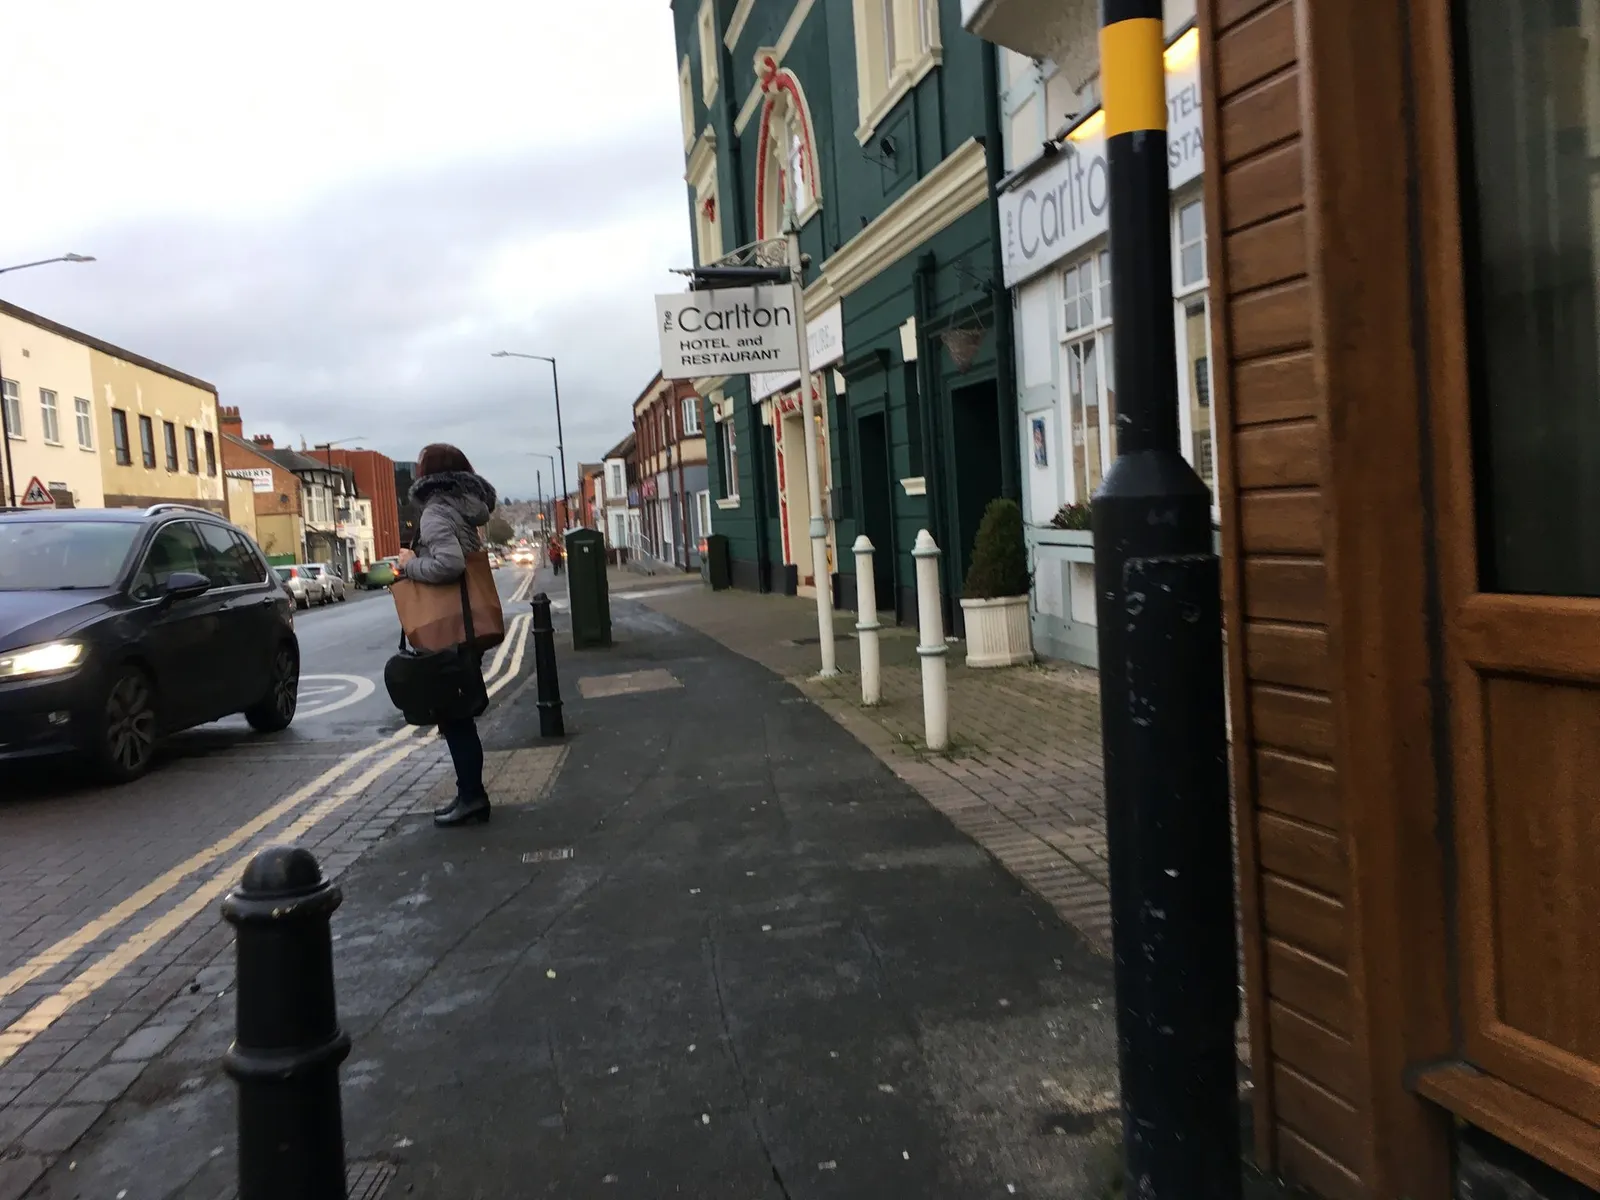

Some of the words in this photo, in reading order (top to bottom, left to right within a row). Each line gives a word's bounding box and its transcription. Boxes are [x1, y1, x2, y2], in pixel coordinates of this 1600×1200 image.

[1168, 82, 1203, 124] TEL
[1168, 127, 1205, 168] STA
[1018, 150, 1109, 260] Carlto
[664, 310, 673, 333] The
[678, 303, 791, 332] Carlton
[680, 337, 731, 351] HOTEL
[737, 335, 763, 348] and
[681, 348, 781, 366] RESTAURANT
